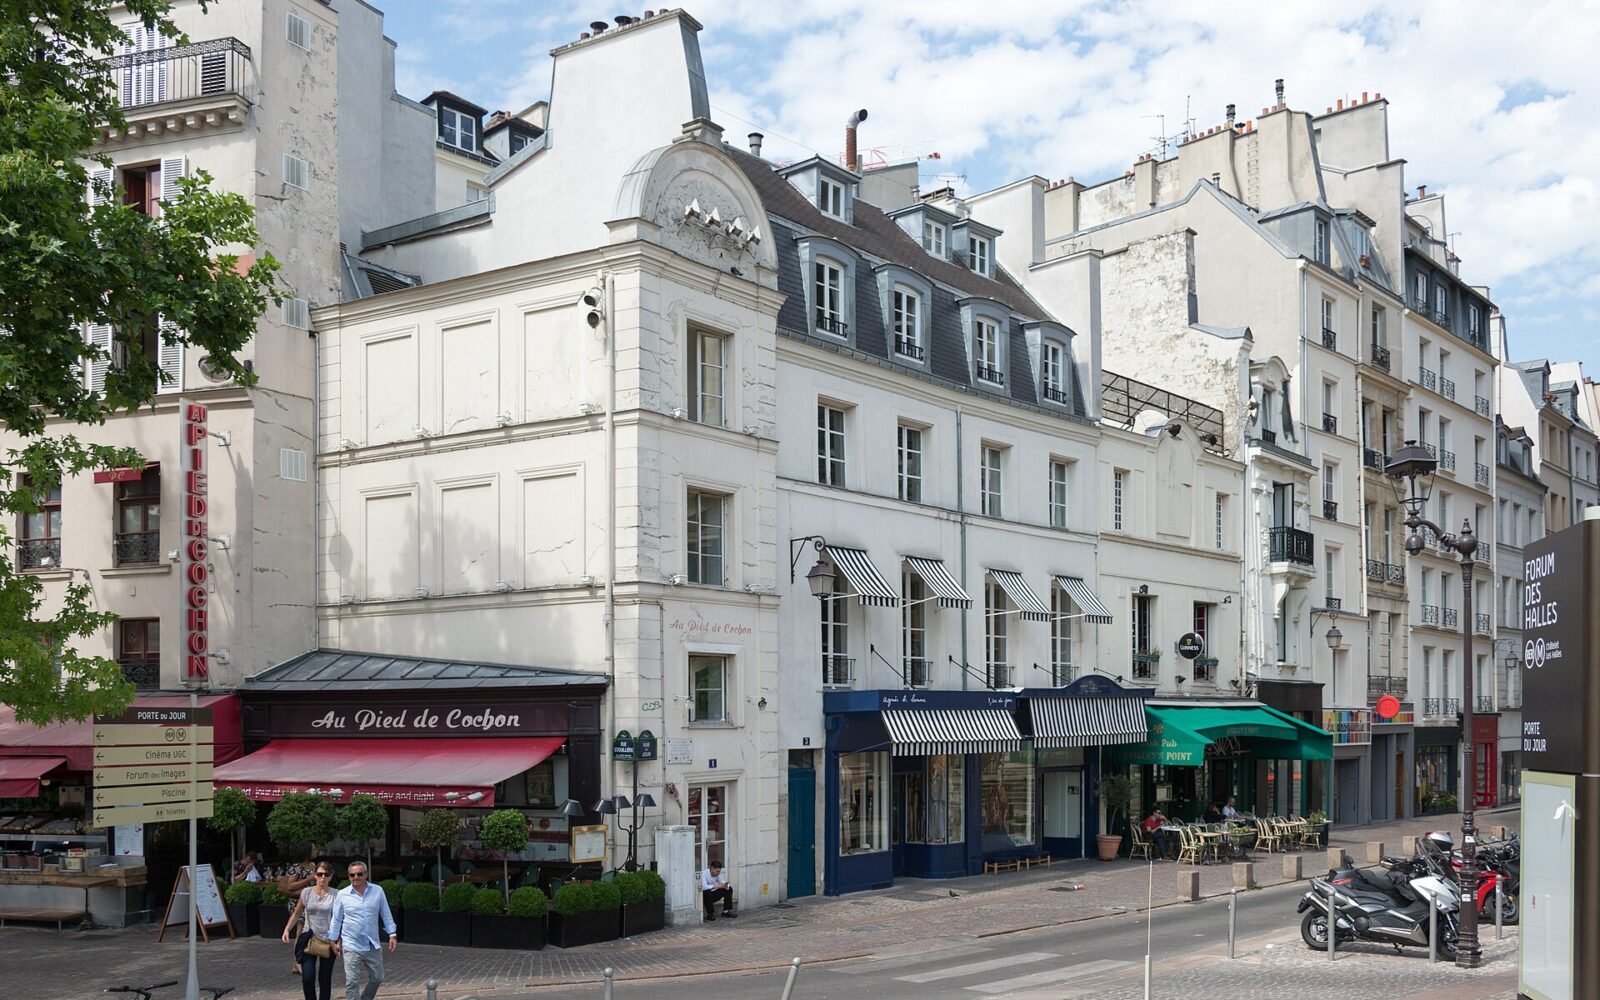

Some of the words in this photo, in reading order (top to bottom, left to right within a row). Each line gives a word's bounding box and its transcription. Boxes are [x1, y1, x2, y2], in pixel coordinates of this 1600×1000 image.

[187, 403, 208, 421] AU
[187, 423, 208, 518] PIED
[187, 519, 208, 538] DE
[1525, 551, 1555, 583] FORUM
[1525, 581, 1542, 607] DES
[187, 540, 208, 678] COCHON
[1525, 601, 1558, 630] HALLES
[711, 622, 722, 633] de
[723, 622, 752, 636] Cochon
[137, 711, 160, 720] PORTE
[168, 711, 187, 720] JOUR
[311, 710, 346, 729] Au
[354, 708, 408, 731] Pied
[413, 708, 439, 729] de
[446, 707, 521, 731] Cochon
[1523, 721, 1541, 735] PORTE
[1161, 739, 1178, 748] Pub
[1523, 738, 1532, 752] DU
[1532, 738, 1547, 752] JOUR
[173, 750, 187, 759] UGC
[1166, 751, 1193, 761] POINT
[126, 771, 149, 780] Forum
[161, 788, 187, 798] Piscine
[378, 790, 394, 802] day
[395, 790, 412, 800] and
[413, 791, 435, 803] night
